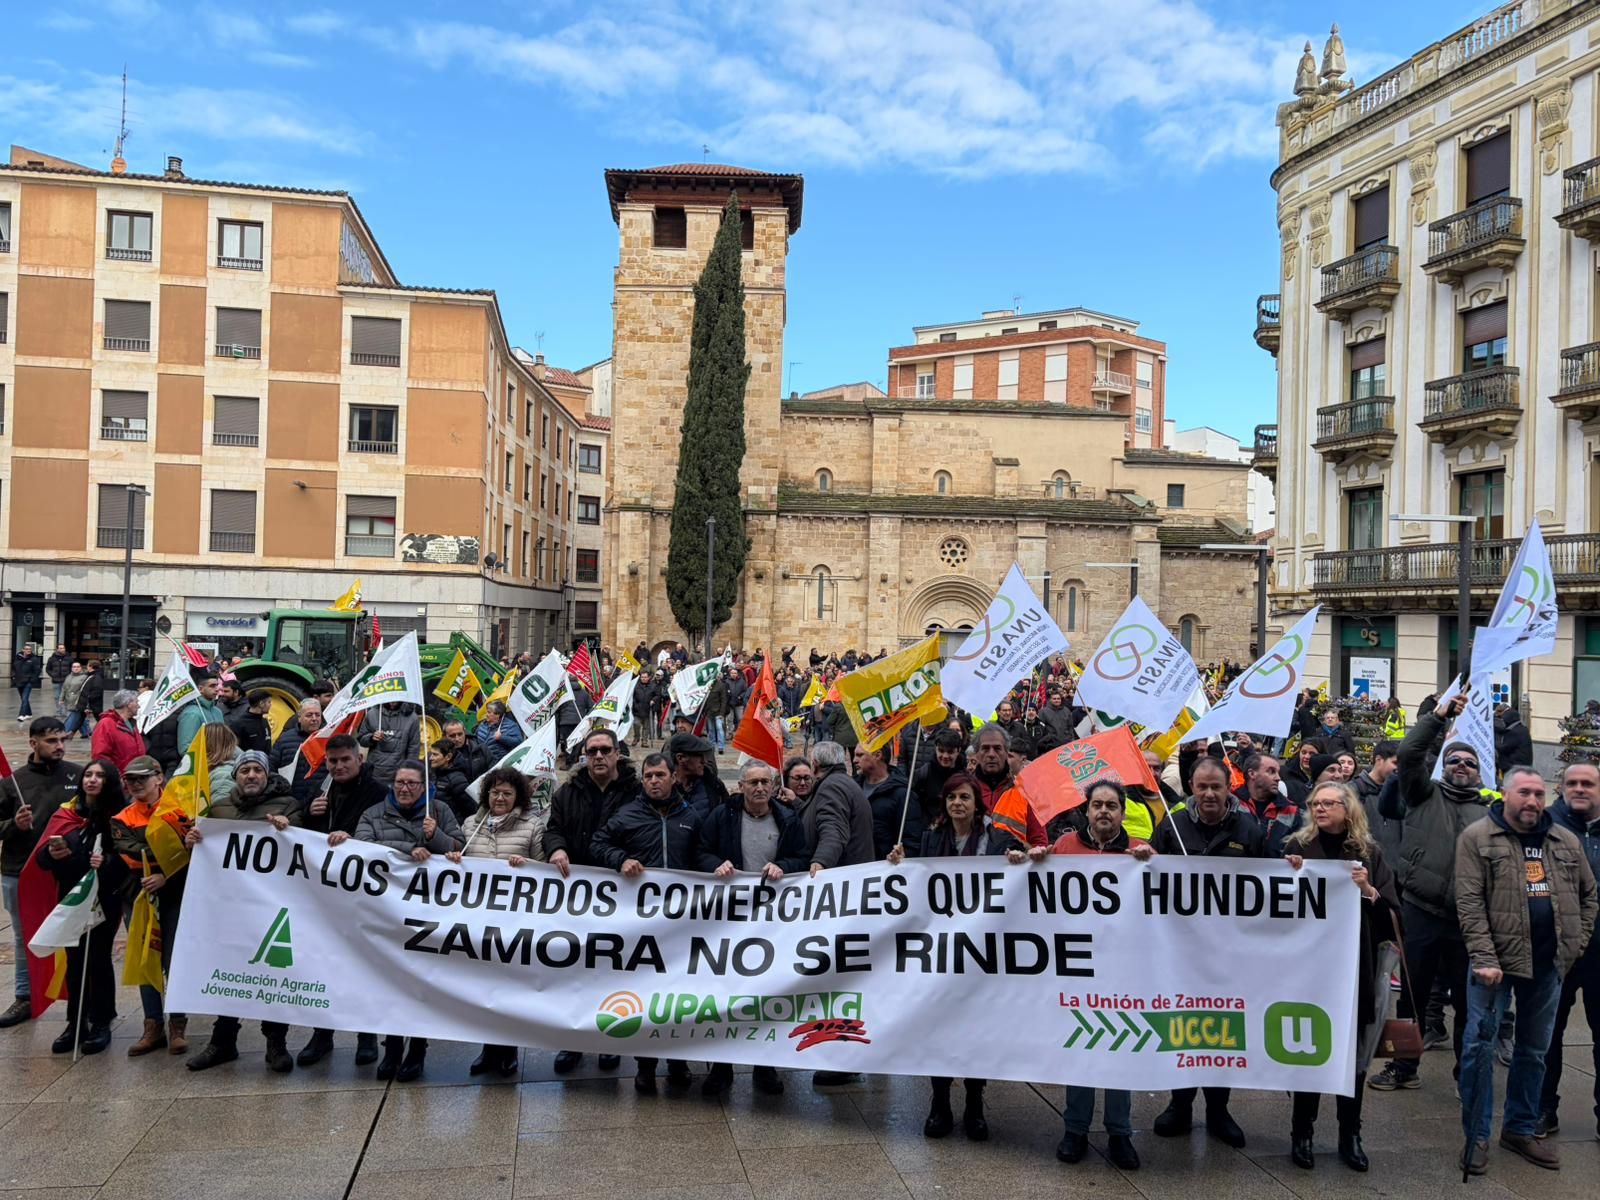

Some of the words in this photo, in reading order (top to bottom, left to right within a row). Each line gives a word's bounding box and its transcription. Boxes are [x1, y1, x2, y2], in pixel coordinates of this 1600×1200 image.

[364, 679, 402, 696] UCCL
[1071, 759, 1110, 779] UPA
[222, 833, 278, 874] NO
[287, 843, 310, 880] A
[321, 850, 389, 896] LOS
[402, 867, 618, 917] ACUERDOS
[636, 872, 909, 922] COMERCIALES
[927, 872, 1005, 918] QUE
[1028, 871, 1121, 915] NOS
[1142, 872, 1327, 919] HUNDEN
[403, 918, 667, 974] ZAMORA
[687, 936, 775, 977] NO
[793, 933, 872, 976] SE
[895, 932, 1095, 977] RINDE
[211, 969, 277, 987] Asociación
[281, 977, 326, 993] Agraria
[201, 983, 253, 999] Jóvenes
[256, 989, 330, 1008] Agricultores
[648, 992, 722, 1024] UPA
[729, 991, 862, 1022] COAG
[1059, 992, 1080, 1008] La
[1086, 993, 1145, 1009] Unión
[1151, 994, 1170, 1009] de
[1175, 994, 1245, 1009] Zamora
[649, 1026, 776, 1042] ALIANZA
[1169, 1015, 1237, 1048] UCCL
[1176, 1053, 1247, 1069] Zamora
